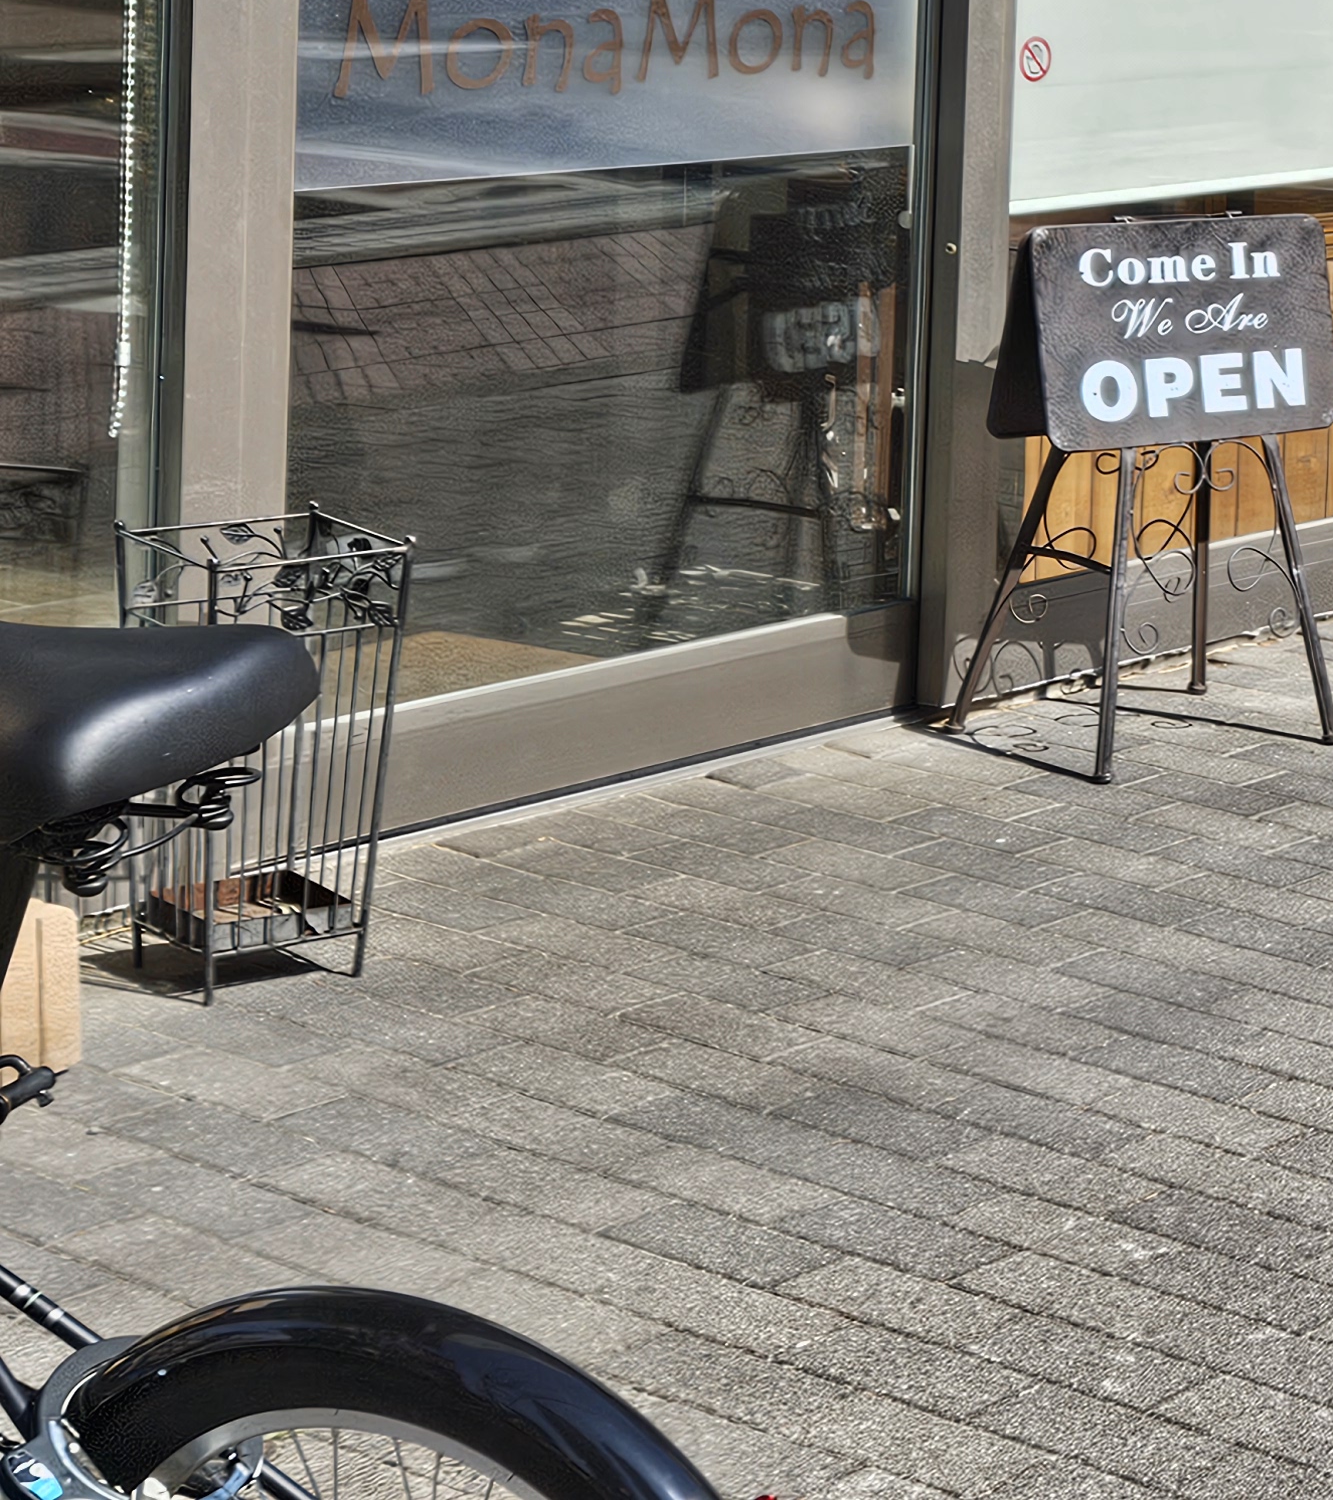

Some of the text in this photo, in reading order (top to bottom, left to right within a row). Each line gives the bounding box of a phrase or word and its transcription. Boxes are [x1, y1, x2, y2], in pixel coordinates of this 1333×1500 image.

[1077, 241, 1281, 288] Come In
[1111, 292, 1269, 340] We Are
[1079, 347, 1307, 423] OPEN
